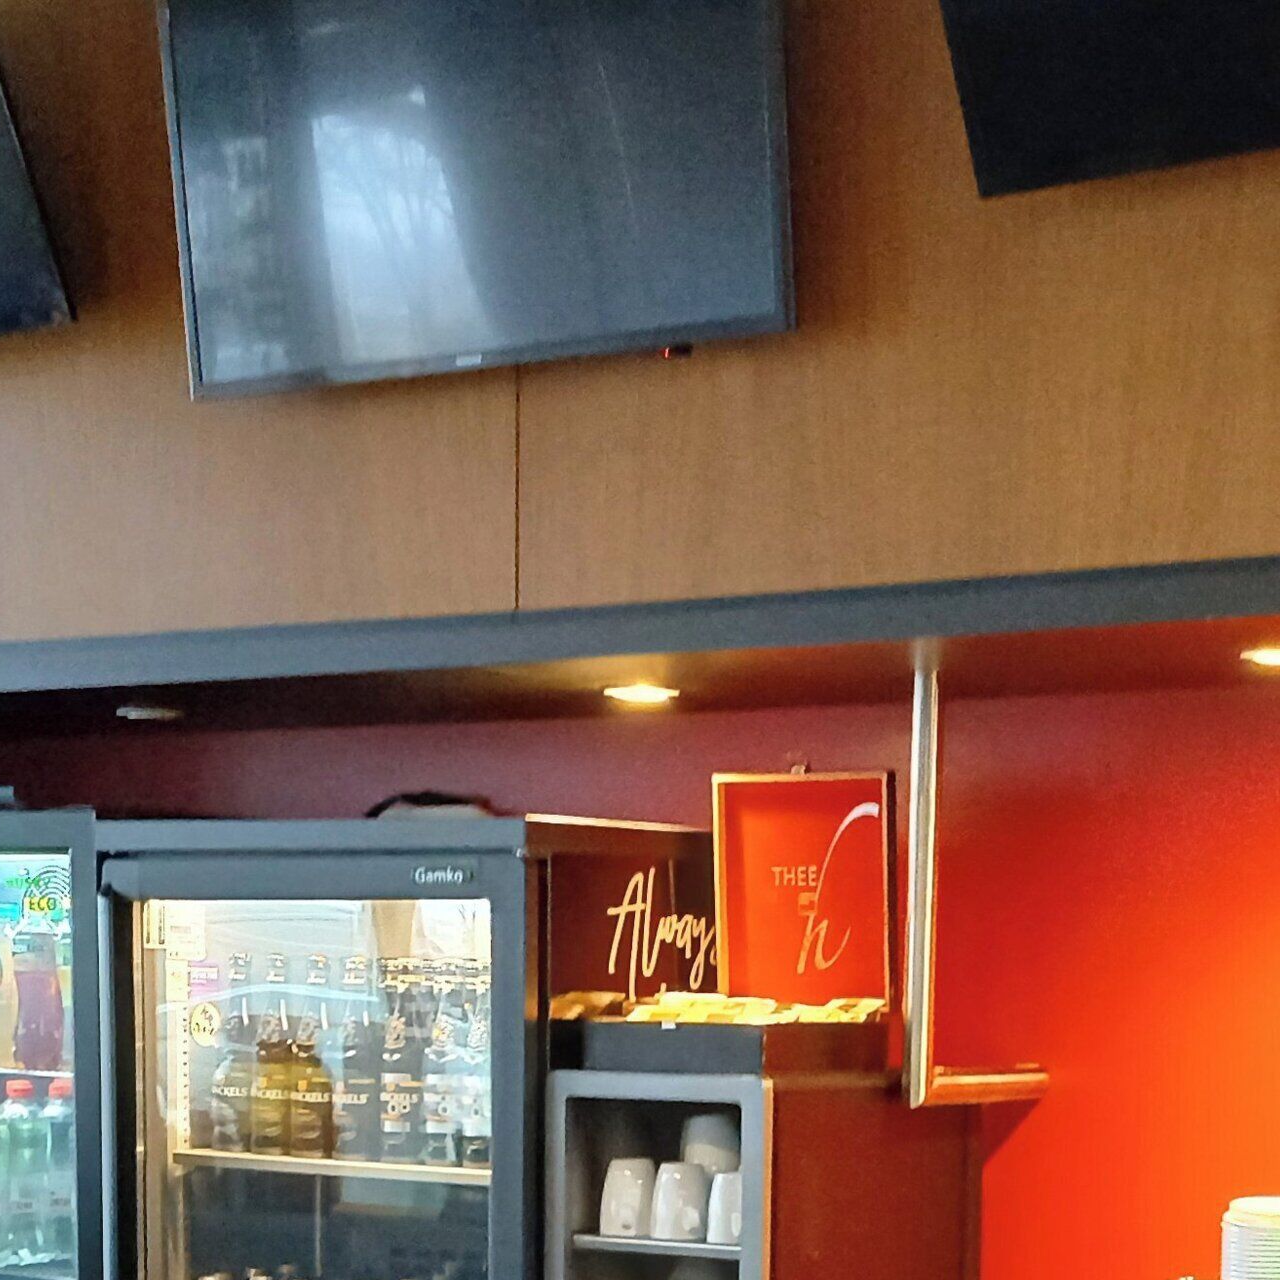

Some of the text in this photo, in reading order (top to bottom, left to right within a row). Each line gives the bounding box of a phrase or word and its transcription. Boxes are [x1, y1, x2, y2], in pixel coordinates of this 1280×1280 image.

[415, 866, 464, 886] Gamko
[770, 865, 817, 887] THEE
[28, 896, 57, 912] ECO
[606, 866, 718, 1001] Alway
